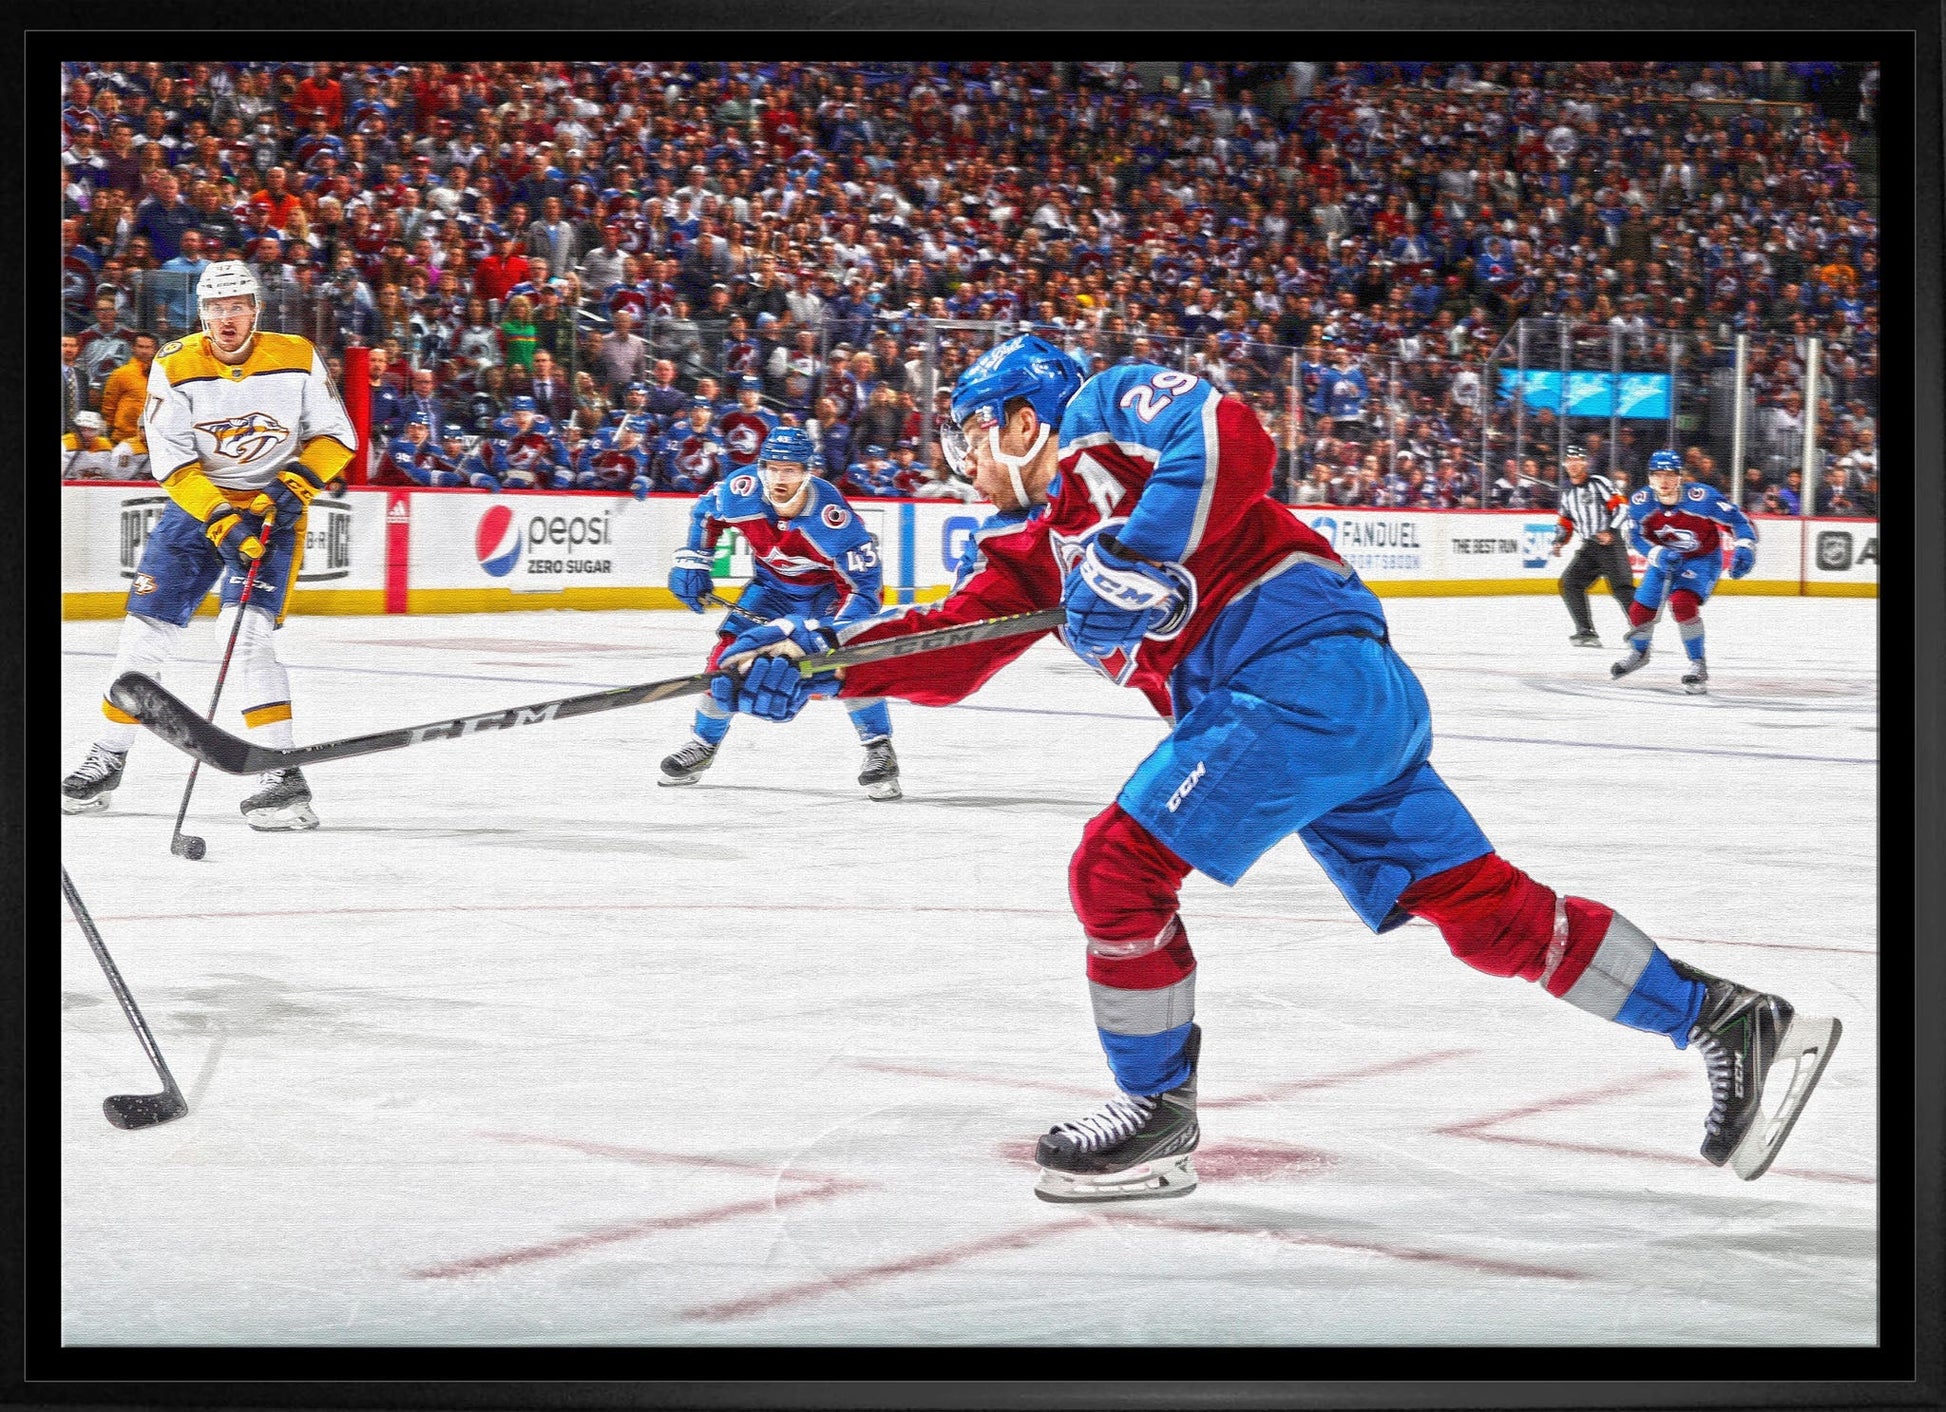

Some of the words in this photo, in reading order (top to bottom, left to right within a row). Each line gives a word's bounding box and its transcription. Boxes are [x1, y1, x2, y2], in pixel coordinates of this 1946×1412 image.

[1119, 370, 1199, 424] 29
[528, 509, 609, 554] pepsi
[1342, 521, 1420, 548] FANDUEL
[1452, 538, 1471, 554] THE
[1473, 538, 1497, 554] BEST
[1498, 538, 1518, 554] RUN
[527, 559, 562, 574] ZERO
[565, 559, 611, 574] SUGAR
[846, 541, 877, 572] 43
[893, 629, 975, 656] CCM
[408, 702, 562, 746] CCM
[1165, 761, 1207, 813] CCM
